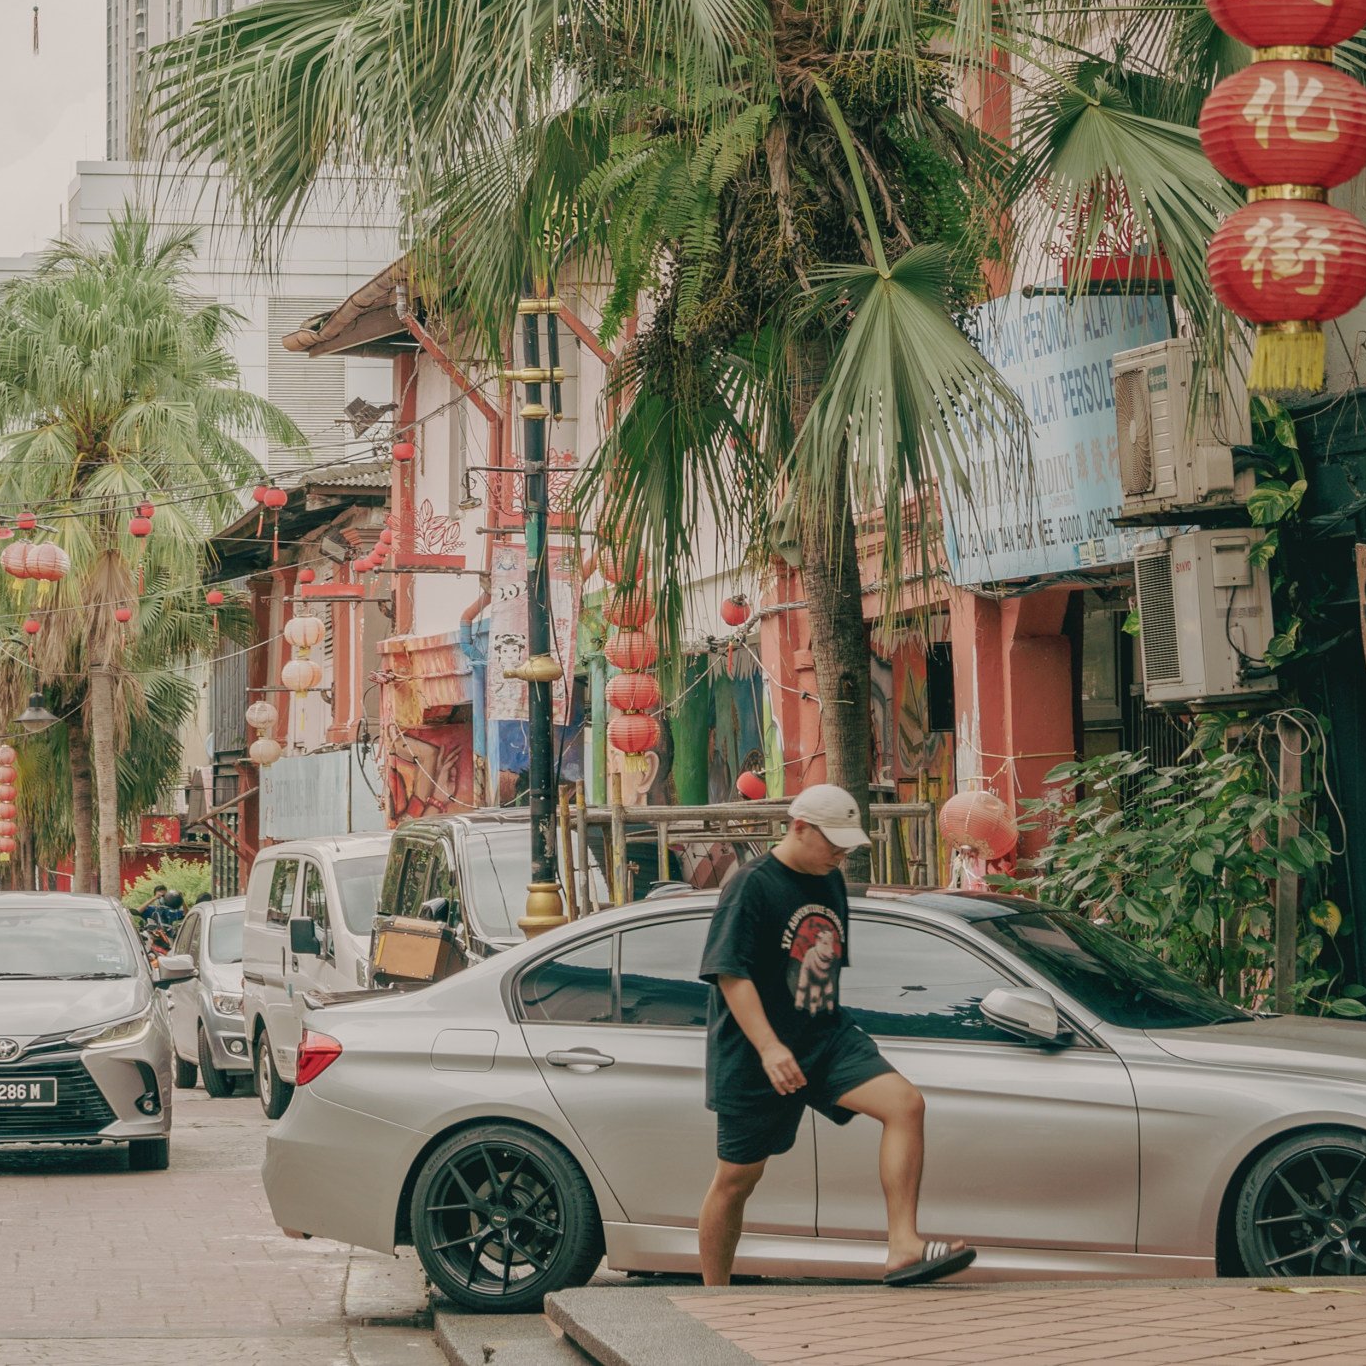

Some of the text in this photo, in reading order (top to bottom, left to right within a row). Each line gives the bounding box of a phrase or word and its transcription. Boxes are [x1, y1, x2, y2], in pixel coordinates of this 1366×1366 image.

[1059, 513, 1084, 544] 80000
[1176, 561, 1191, 572] SANYO
[29, 1084, 41, 1100] M
